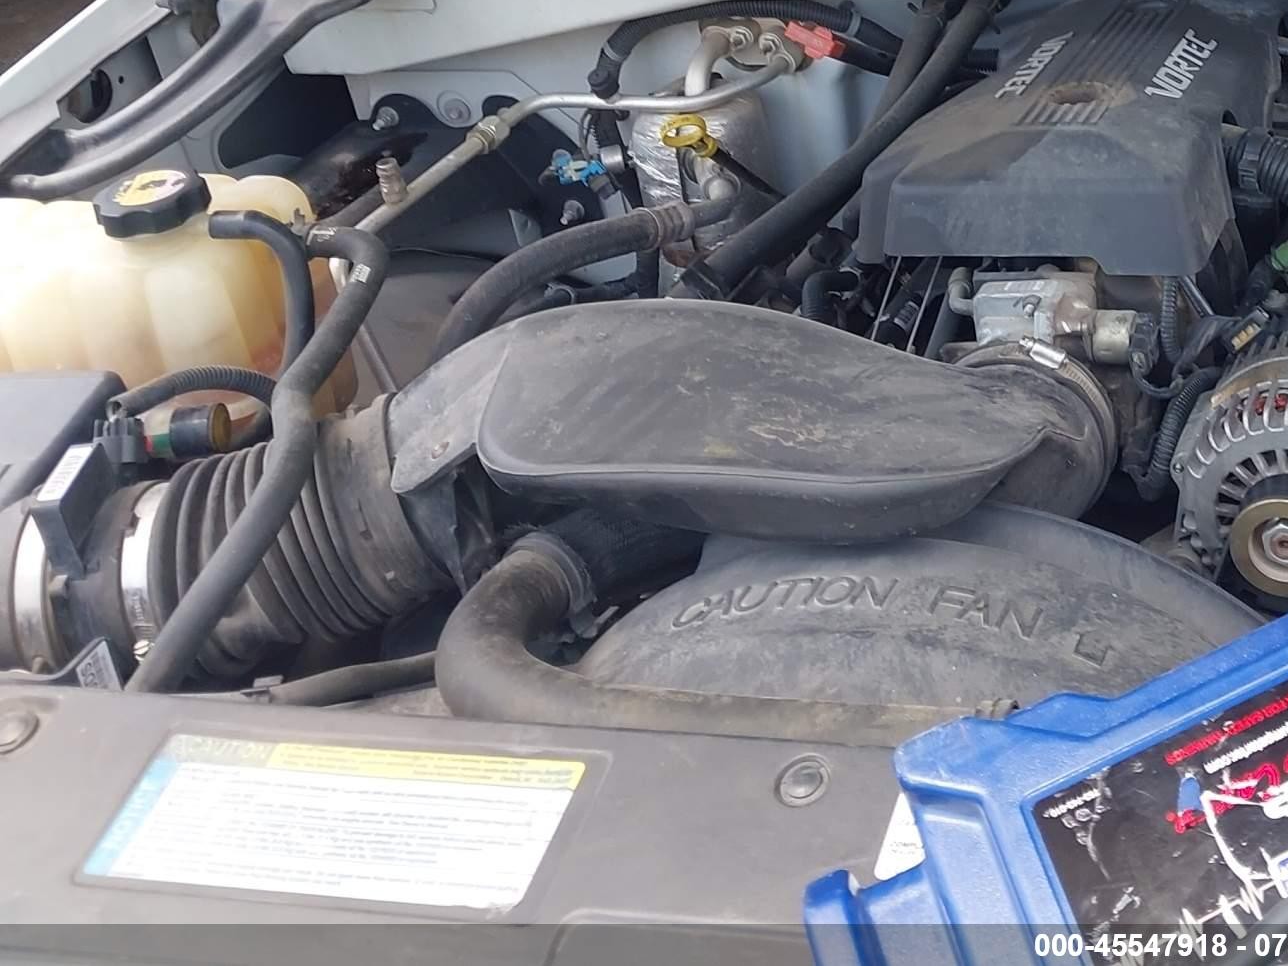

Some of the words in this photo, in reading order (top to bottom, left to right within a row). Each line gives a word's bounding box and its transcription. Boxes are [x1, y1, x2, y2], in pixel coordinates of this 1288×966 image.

[994, 31, 1075, 99] VORTEC
[1143, 28, 1219, 100] VORTEC
[670, 575, 900, 631] CAUTION
[927, 584, 1044, 641] FAN
